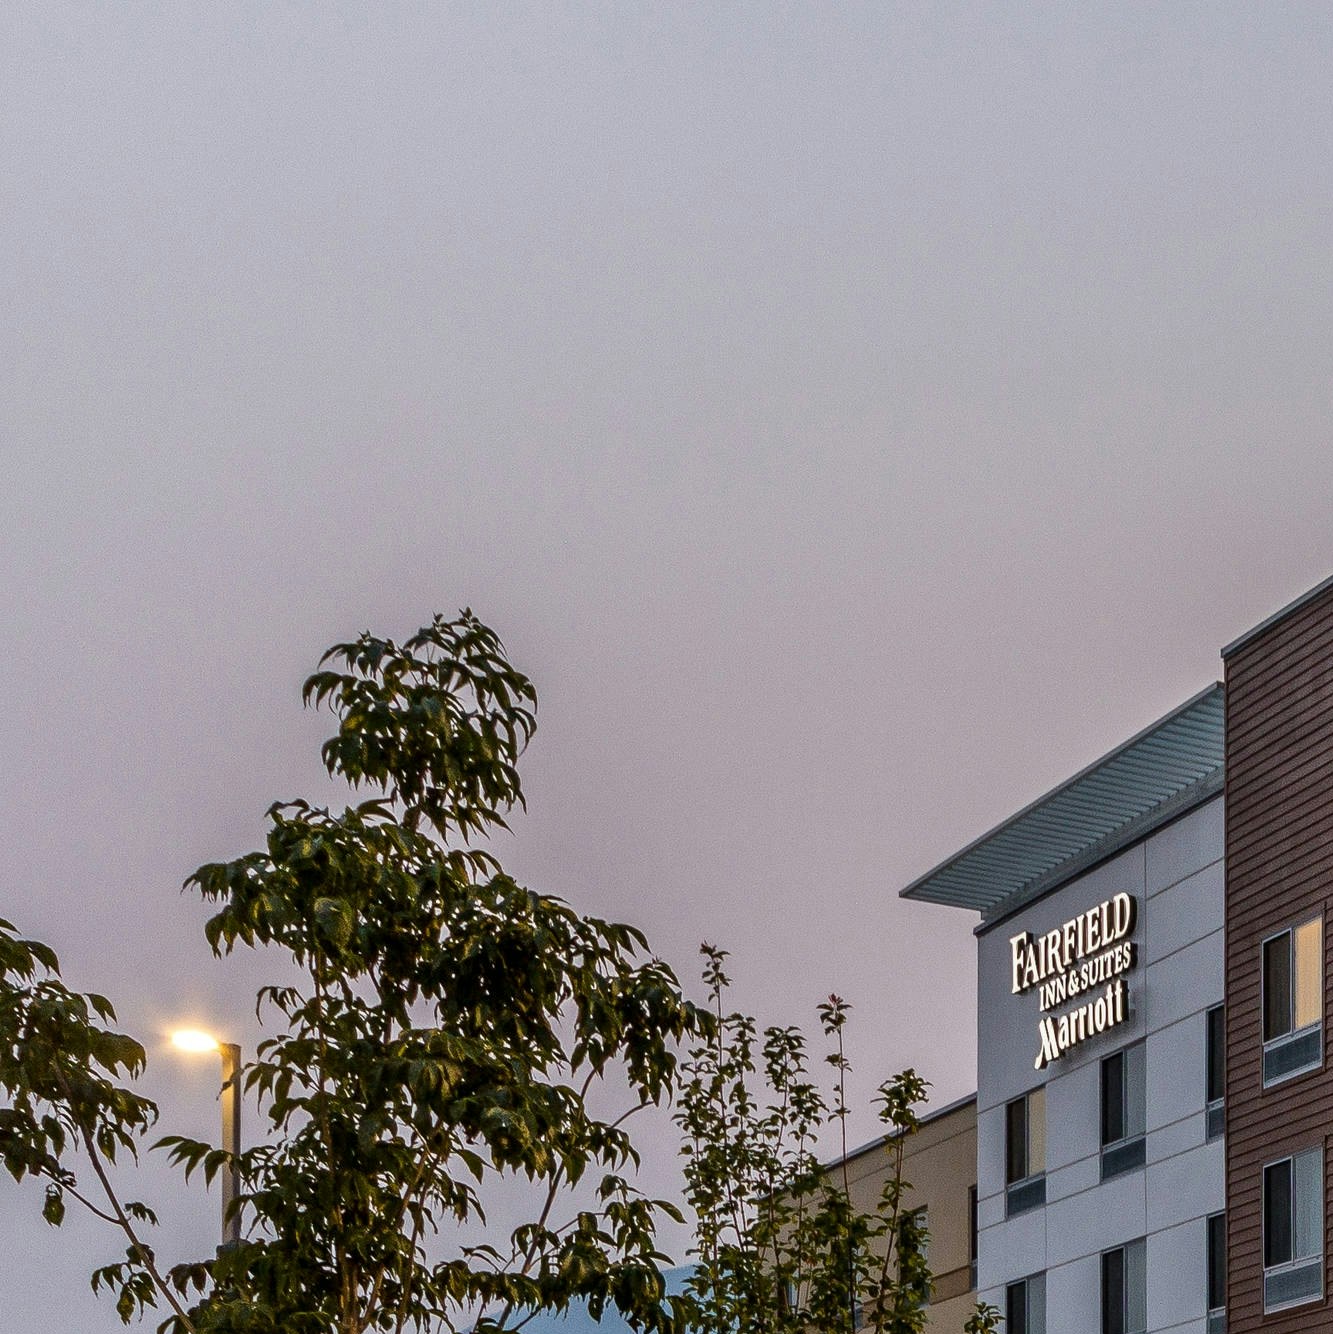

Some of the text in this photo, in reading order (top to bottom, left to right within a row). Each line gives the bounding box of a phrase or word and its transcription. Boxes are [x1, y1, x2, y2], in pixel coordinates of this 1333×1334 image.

[1010, 892, 1133, 994] FAIRFIELD
[1039, 942, 1133, 1012] INN & SUITES
[1034, 979, 1125, 1070] Marriott
